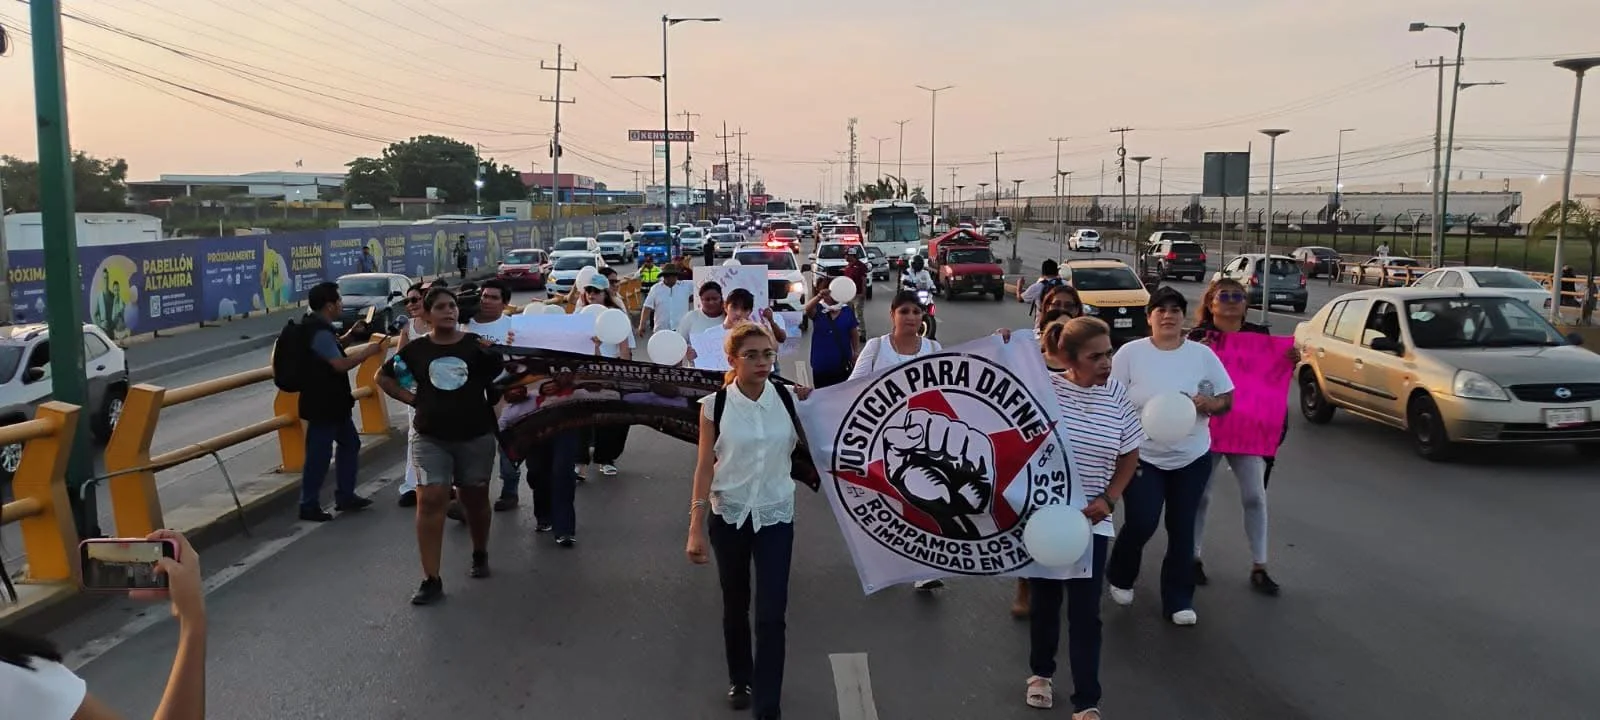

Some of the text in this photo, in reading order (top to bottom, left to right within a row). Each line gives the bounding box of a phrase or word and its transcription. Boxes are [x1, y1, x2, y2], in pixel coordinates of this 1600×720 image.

[143, 253, 193, 274] PABELLÓN
[145, 272, 193, 291] ALTAMIRA
[839, 360, 1048, 476] JUSTICIA PARA DAFNE
[852, 503, 873, 528] DE
[873, 524, 976, 570] IMPUNIDAD
[980, 556, 1004, 571] EN
[866, 498, 972, 556] ROMPAMOS
[976, 535, 1010, 557] LOS
